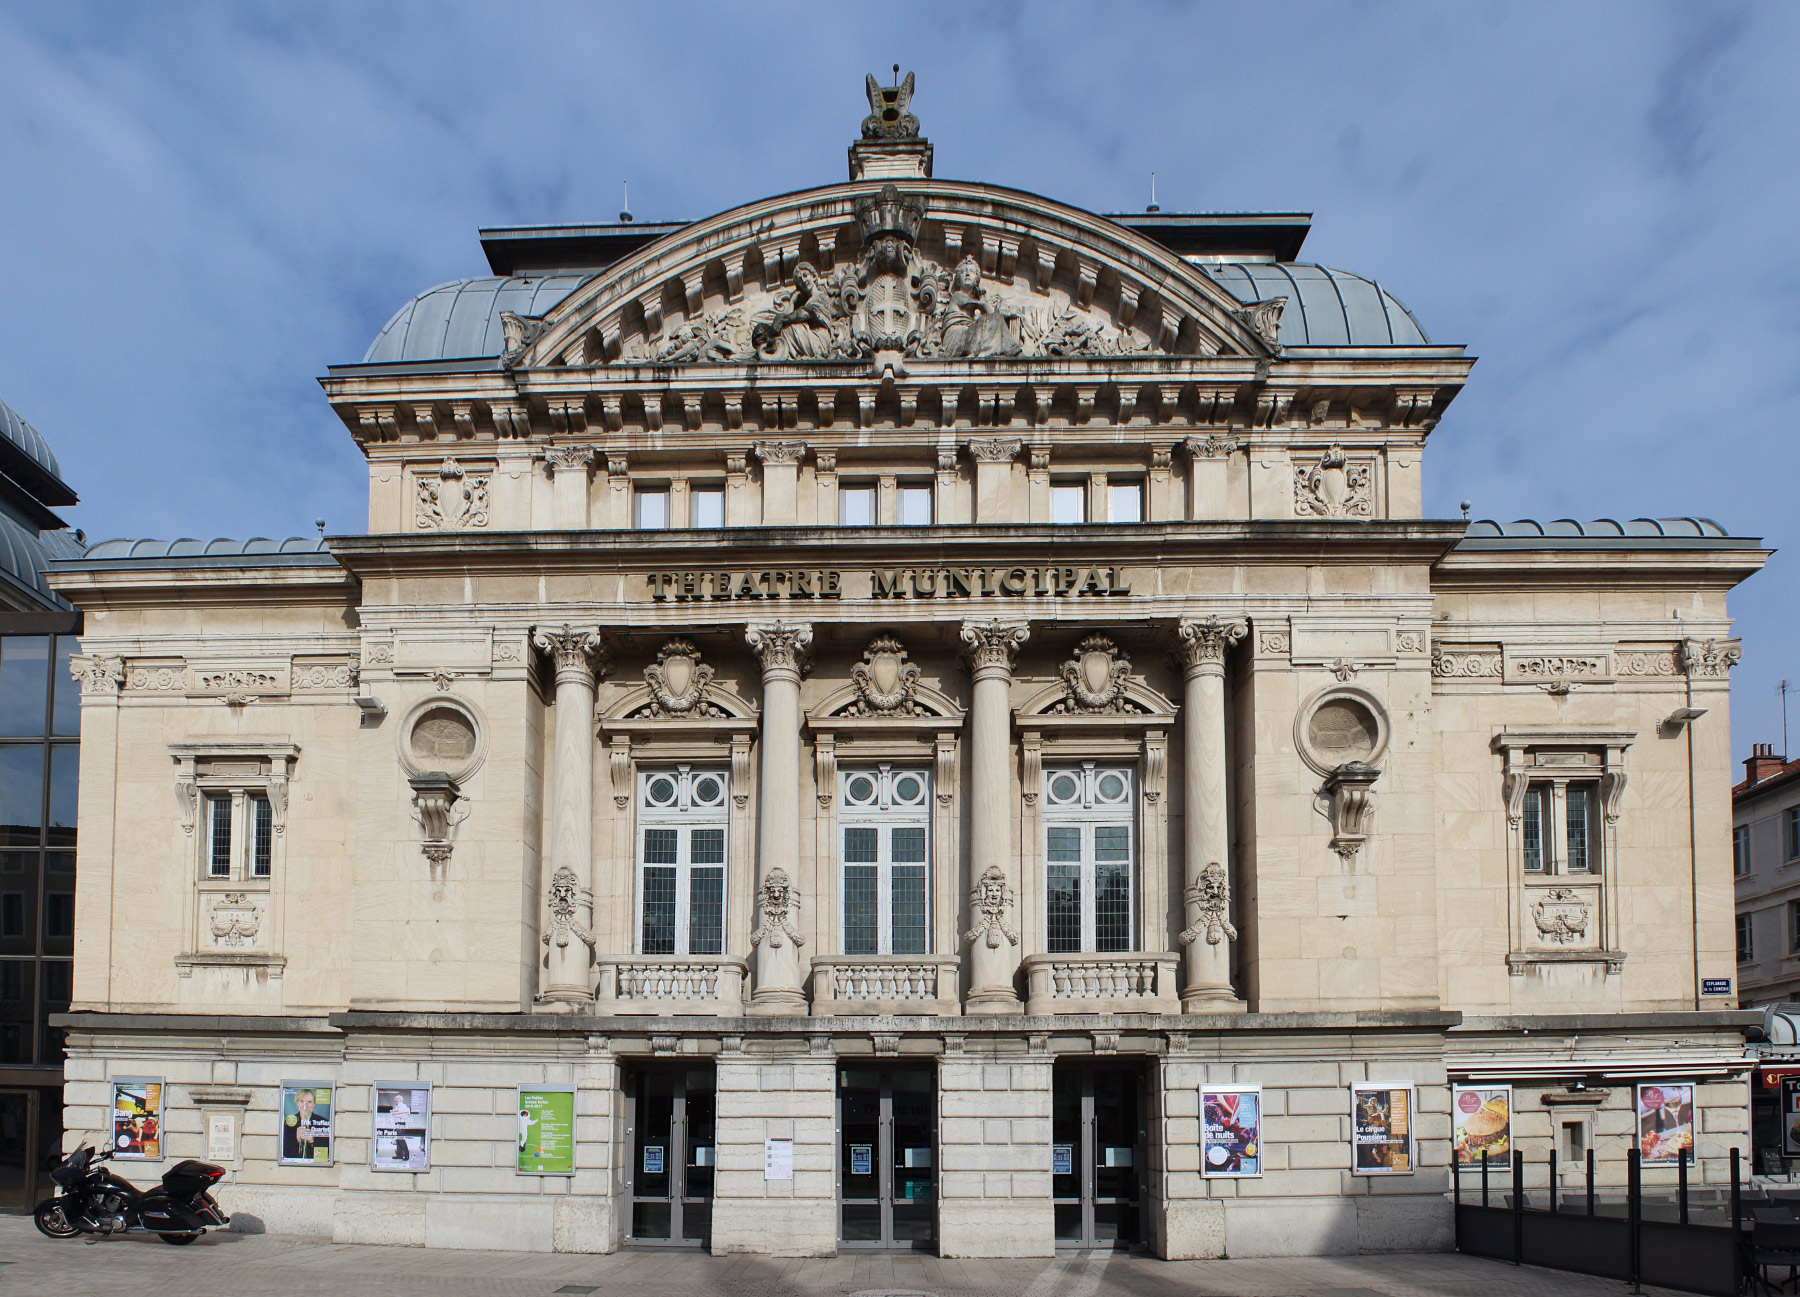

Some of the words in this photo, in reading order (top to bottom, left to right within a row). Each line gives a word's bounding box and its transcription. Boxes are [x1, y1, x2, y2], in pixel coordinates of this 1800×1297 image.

[646, 569, 842, 600] THEATRE
[871, 565, 1132, 599] MUNICIPAL
[115, 1109, 133, 1118] Bang
[1365, 1126, 1385, 1134] cirque
[1204, 1131, 1213, 1139] de
[1215, 1131, 1235, 1139] nuits
